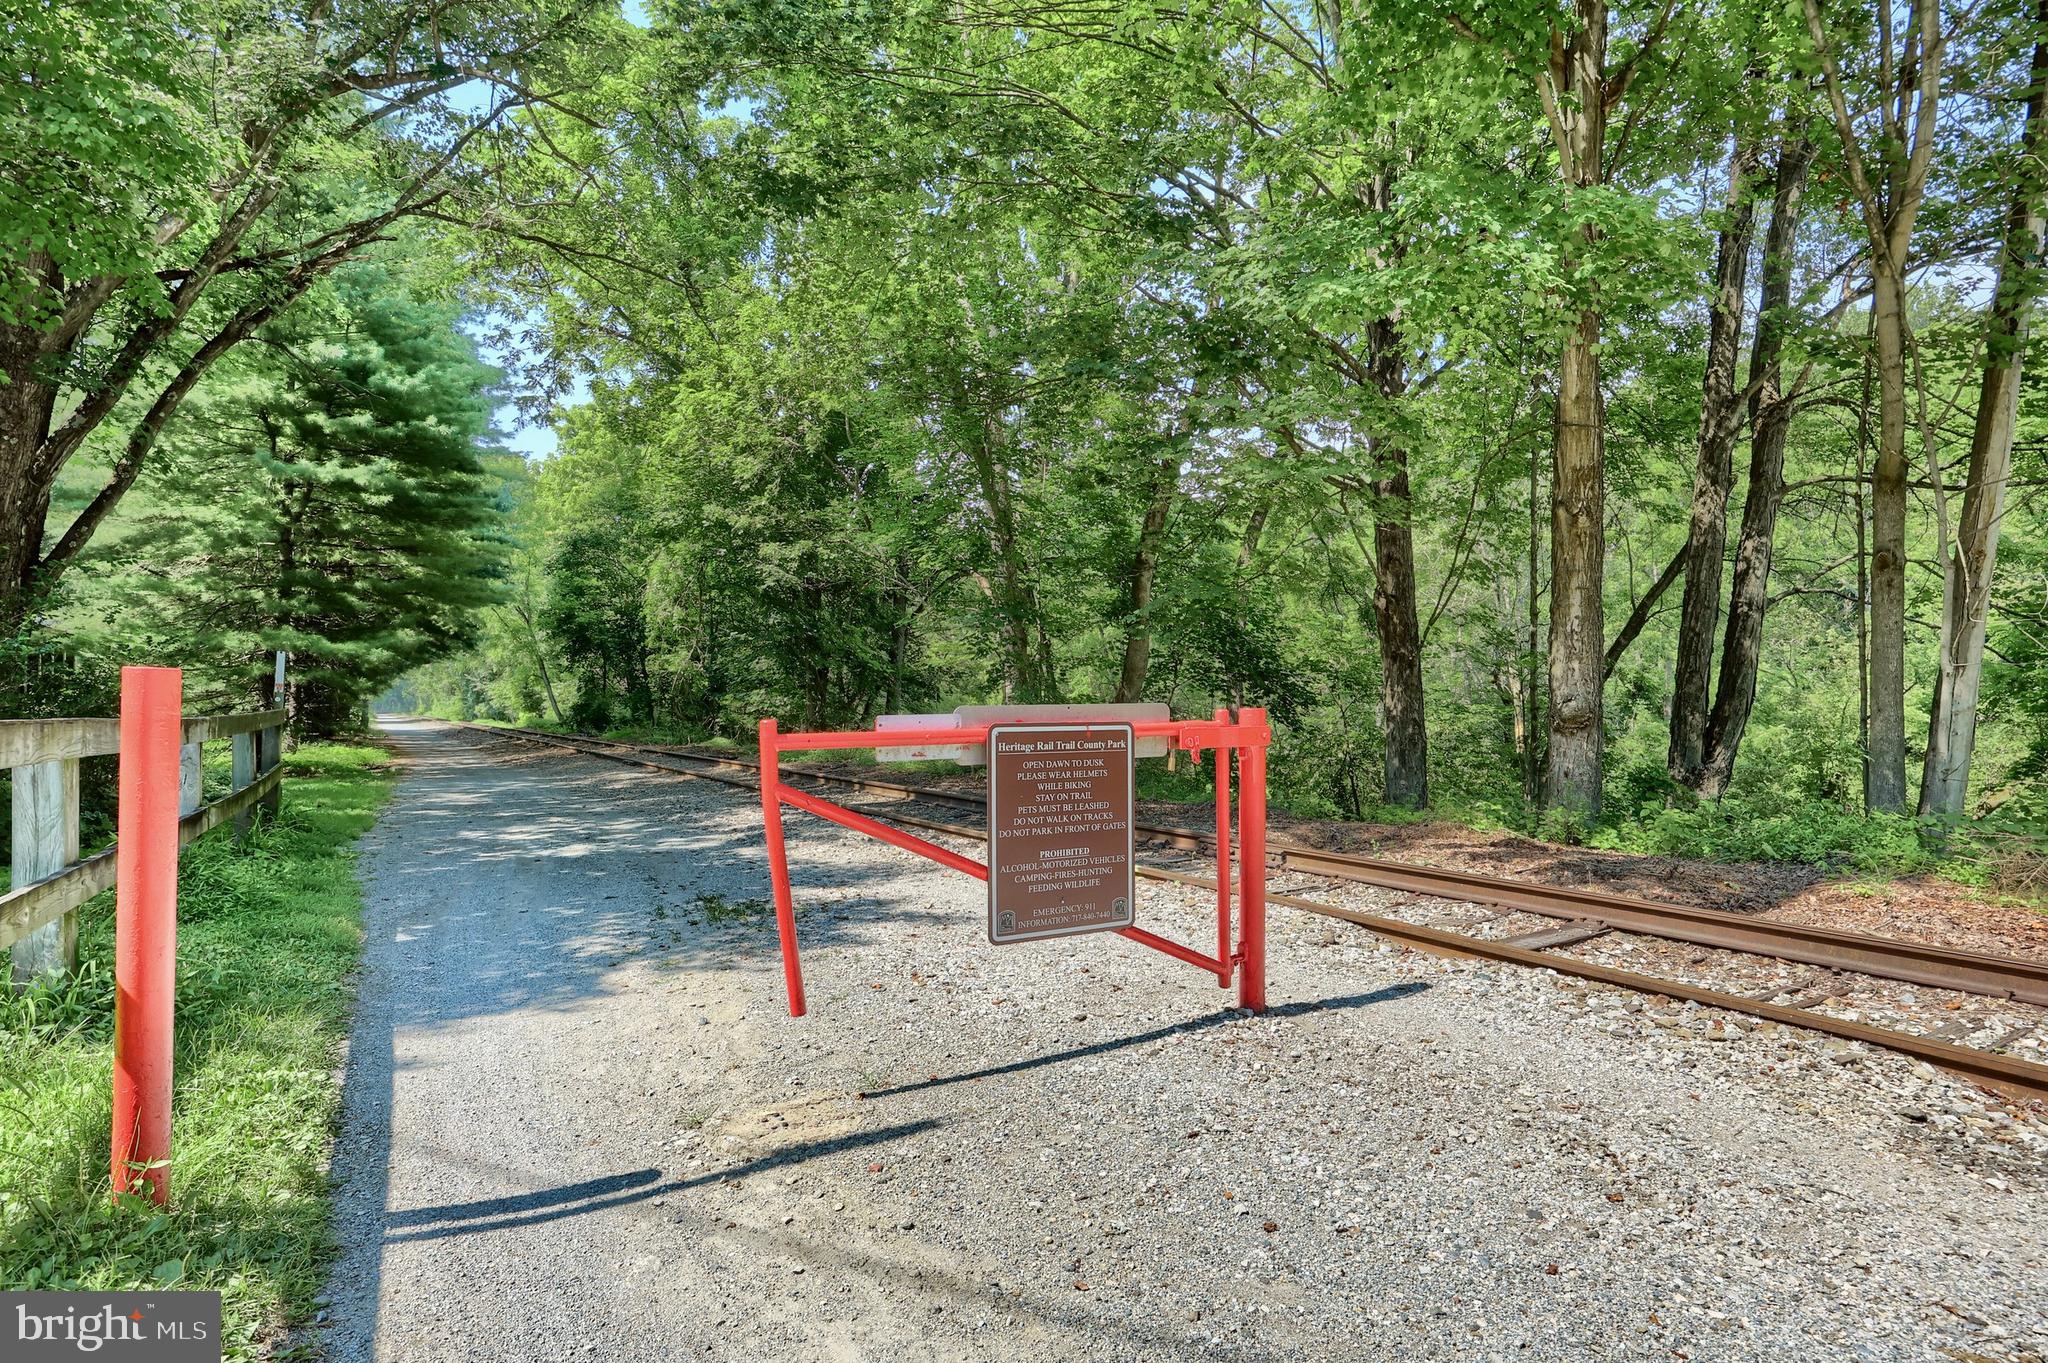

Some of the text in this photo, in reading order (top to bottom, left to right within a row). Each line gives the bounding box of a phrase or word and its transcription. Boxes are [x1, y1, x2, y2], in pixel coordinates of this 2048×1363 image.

[998, 740, 1126, 753] Heritage Rail Trail County Park
[1023, 761, 1044, 769] OPEN
[1018, 772, 1047, 780] PLEASE
[1073, 770, 1107, 778] HELMETS
[1018, 806, 1037, 814] PETS
[1039, 804, 1061, 813] MUST
[1074, 802, 1110, 810] LEASHED
[1084, 812, 1113, 820] TRACKS
[999, 830, 1012, 838] DO
[1013, 828, 1031, 837] NOT
[1032, 827, 1053, 835] PARK
[1065, 824, 1090, 832] FRONT
[1103, 821, 1126, 830] GATES
[1040, 847, 1090, 858] PROHIBITED
[1000, 855, 1125, 873] ALCOHOL-MOTORIZED VEHICLES
[1014, 867, 1113, 883] CAMPING-FIRES-HUNTING
[1028, 878, 1101, 893] FEEDING WILDLIFE
[1033, 904, 1084, 916] EMERGENCY:
[1018, 915, 1071, 928] INFORMATION:
